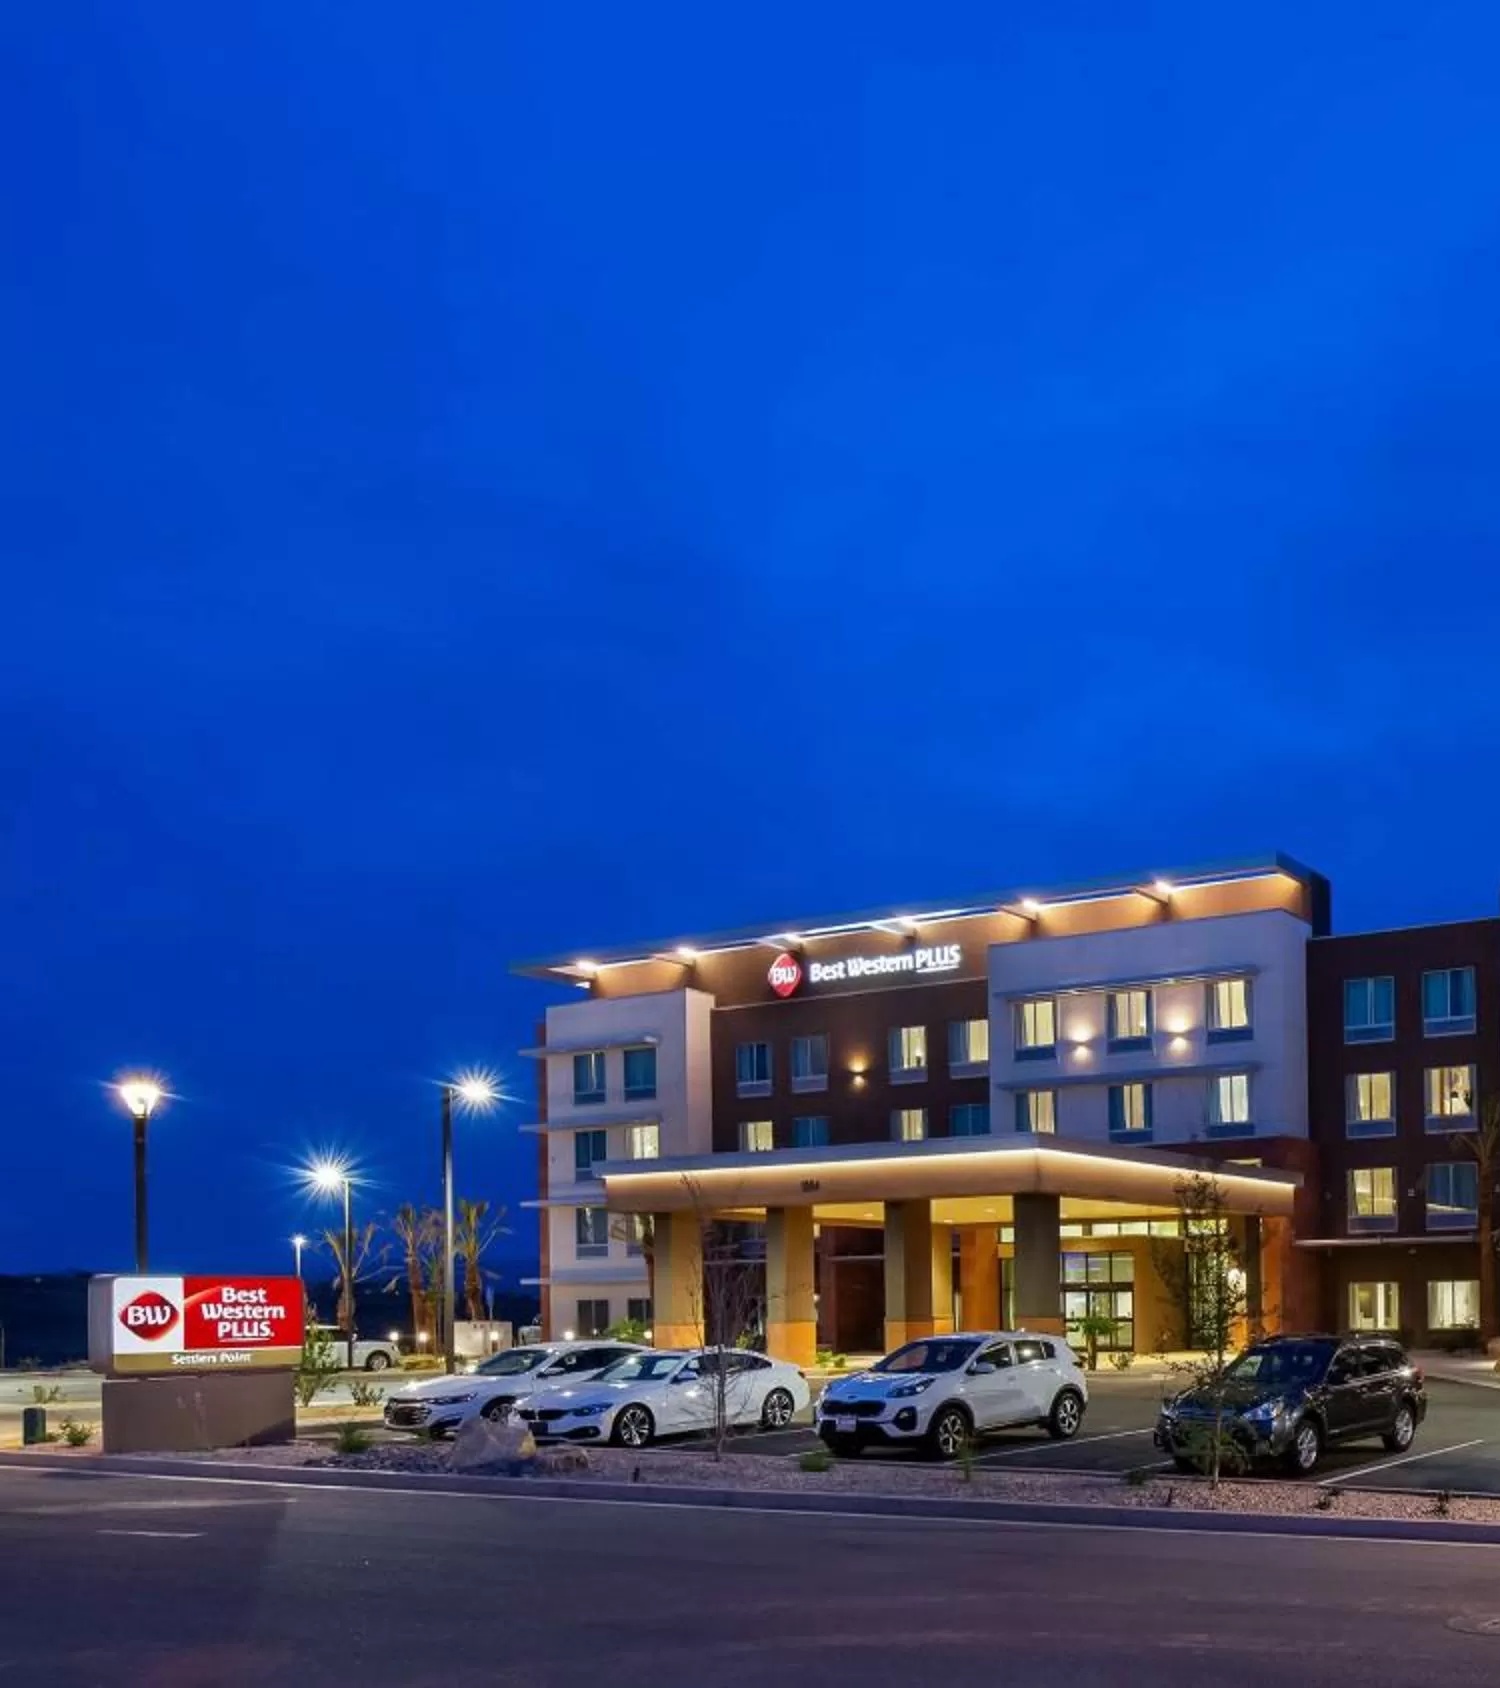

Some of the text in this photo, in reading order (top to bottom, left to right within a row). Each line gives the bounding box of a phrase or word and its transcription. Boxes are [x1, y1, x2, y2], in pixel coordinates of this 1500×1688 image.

[809, 945, 961, 983] Best Western PLUS
[773, 967, 797, 984] BW
[221, 1287, 267, 1302] Best
[127, 1305, 171, 1326] BW
[202, 1303, 285, 1320] Western
